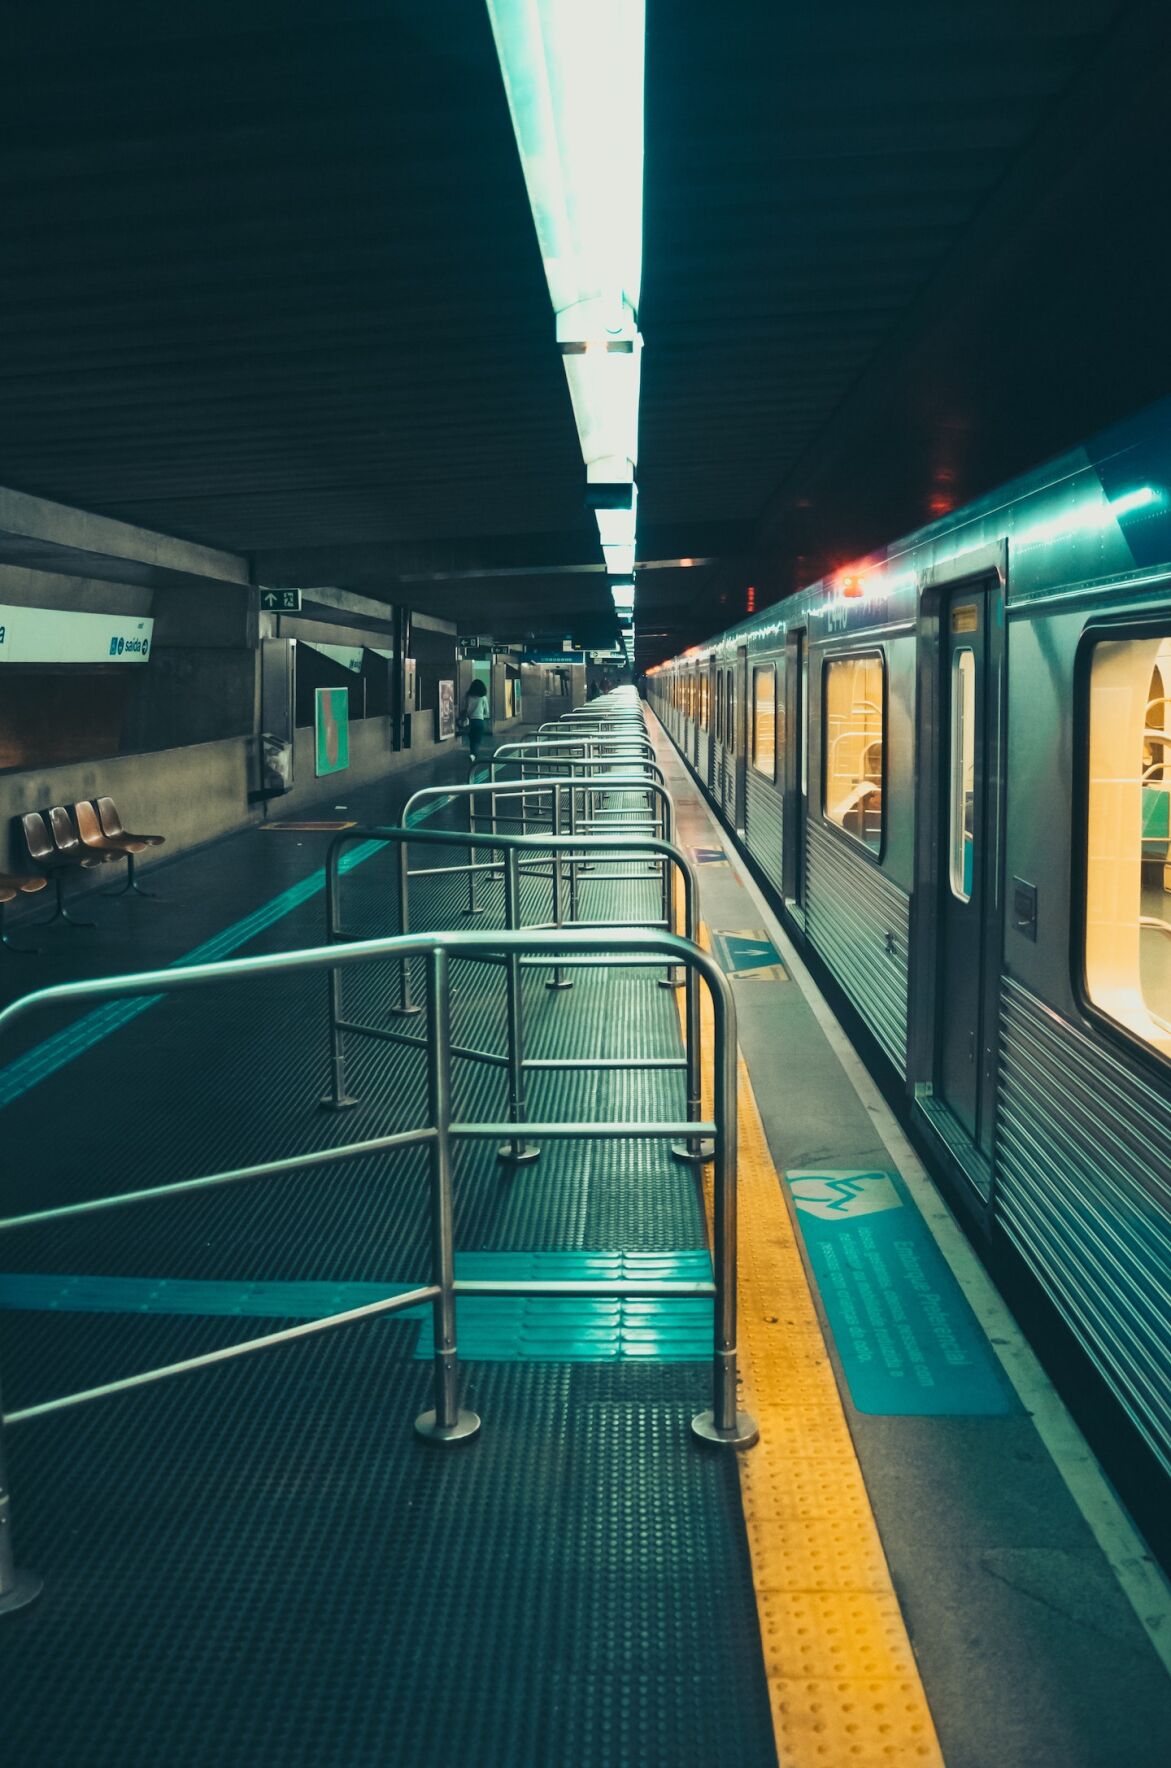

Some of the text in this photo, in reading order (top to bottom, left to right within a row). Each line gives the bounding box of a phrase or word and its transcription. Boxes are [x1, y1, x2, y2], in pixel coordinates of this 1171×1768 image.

[125, 637, 141, 653] saída
[894, 1241, 971, 1364] Embarque Preferencial
